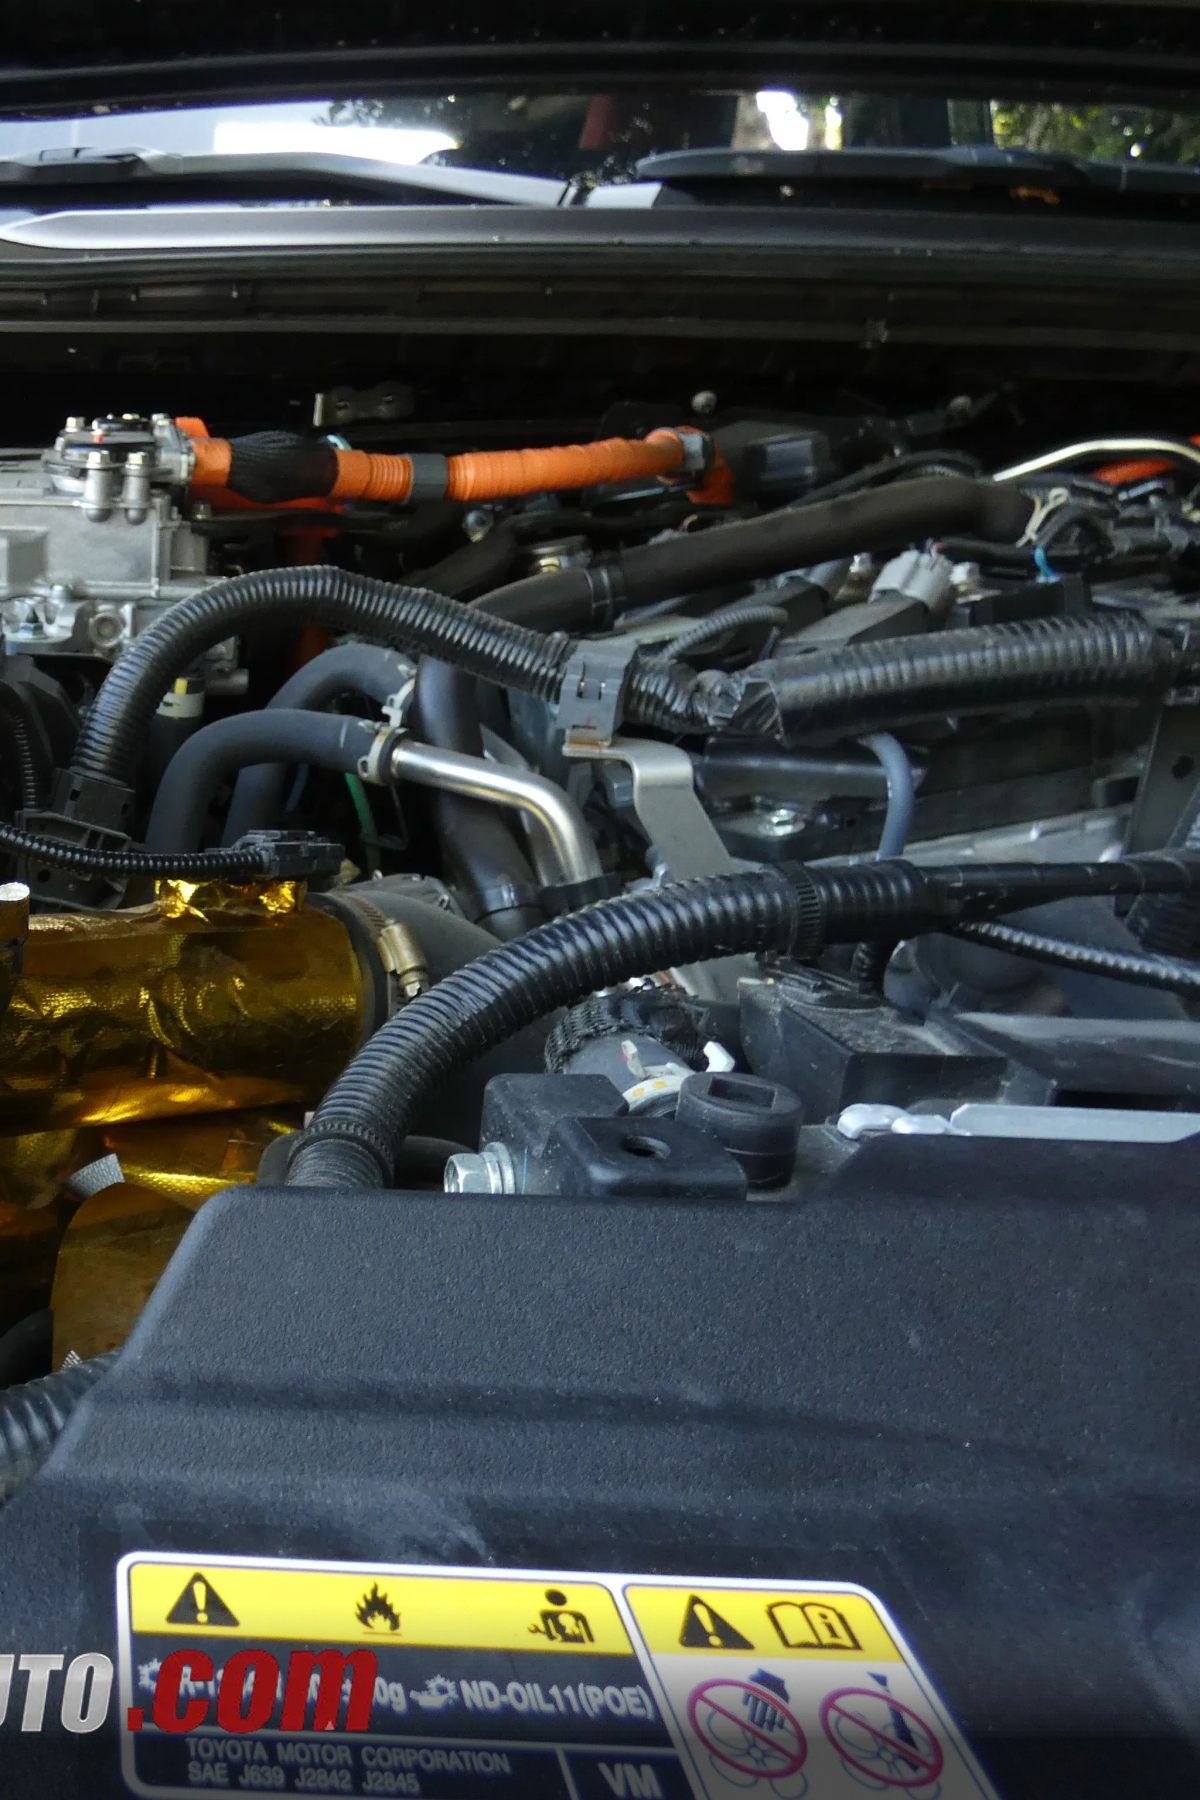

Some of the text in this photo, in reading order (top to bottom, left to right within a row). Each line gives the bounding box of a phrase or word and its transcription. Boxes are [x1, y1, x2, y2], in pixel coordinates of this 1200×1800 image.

[460, 1679, 654, 1718] ND-OIL11(POE)
[184, 1737, 513, 1776] TOYOTA MOTOR CORPORATION
[187, 1759, 422, 1795] SAE J639 J2842 J2845
[598, 1762, 664, 1799] VM
